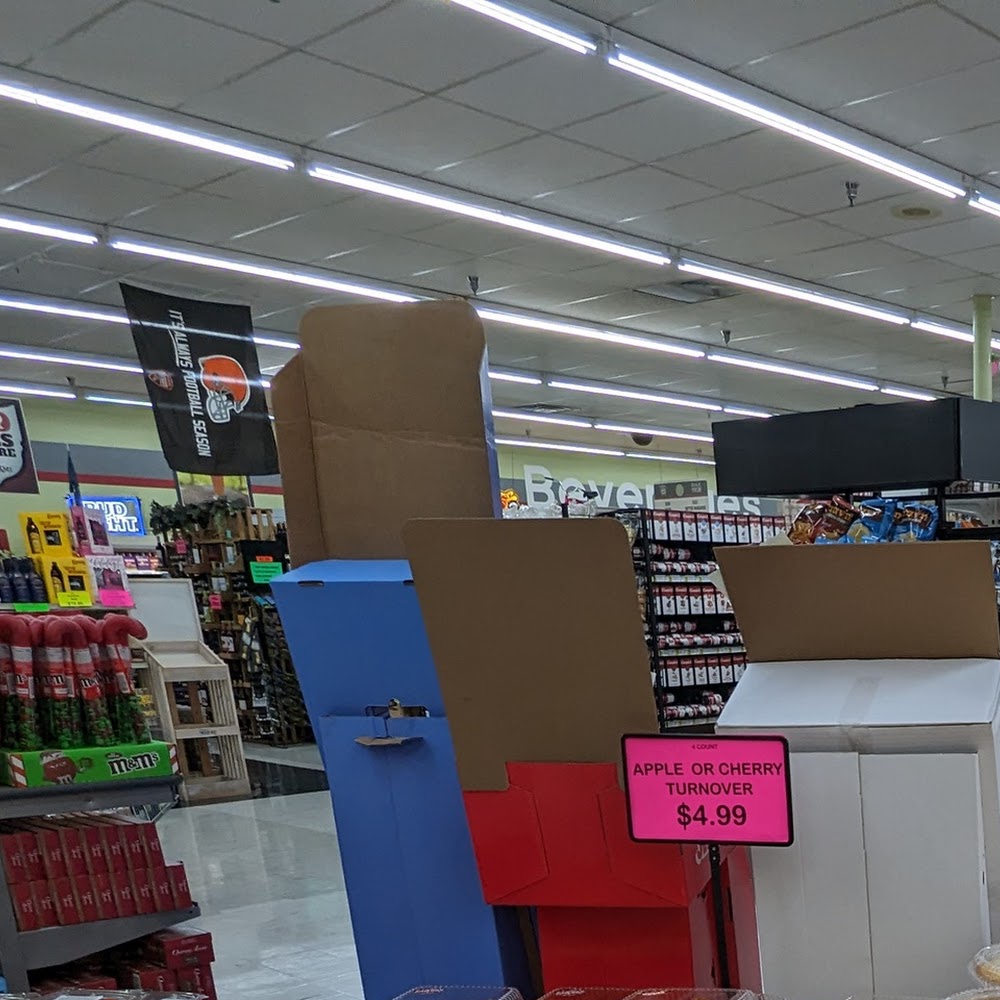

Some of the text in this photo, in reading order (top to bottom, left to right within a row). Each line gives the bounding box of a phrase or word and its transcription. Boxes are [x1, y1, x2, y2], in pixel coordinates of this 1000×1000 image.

[174, 329, 194, 369] ALWAYS
[183, 369, 204, 419] FOOTBALL
[193, 417, 213, 458] SEASON
[633, 763, 783, 776] APPLE OR CHERRY
[666, 782, 753, 796] TURNOVER
[677, 802, 747, 831] $4.99
